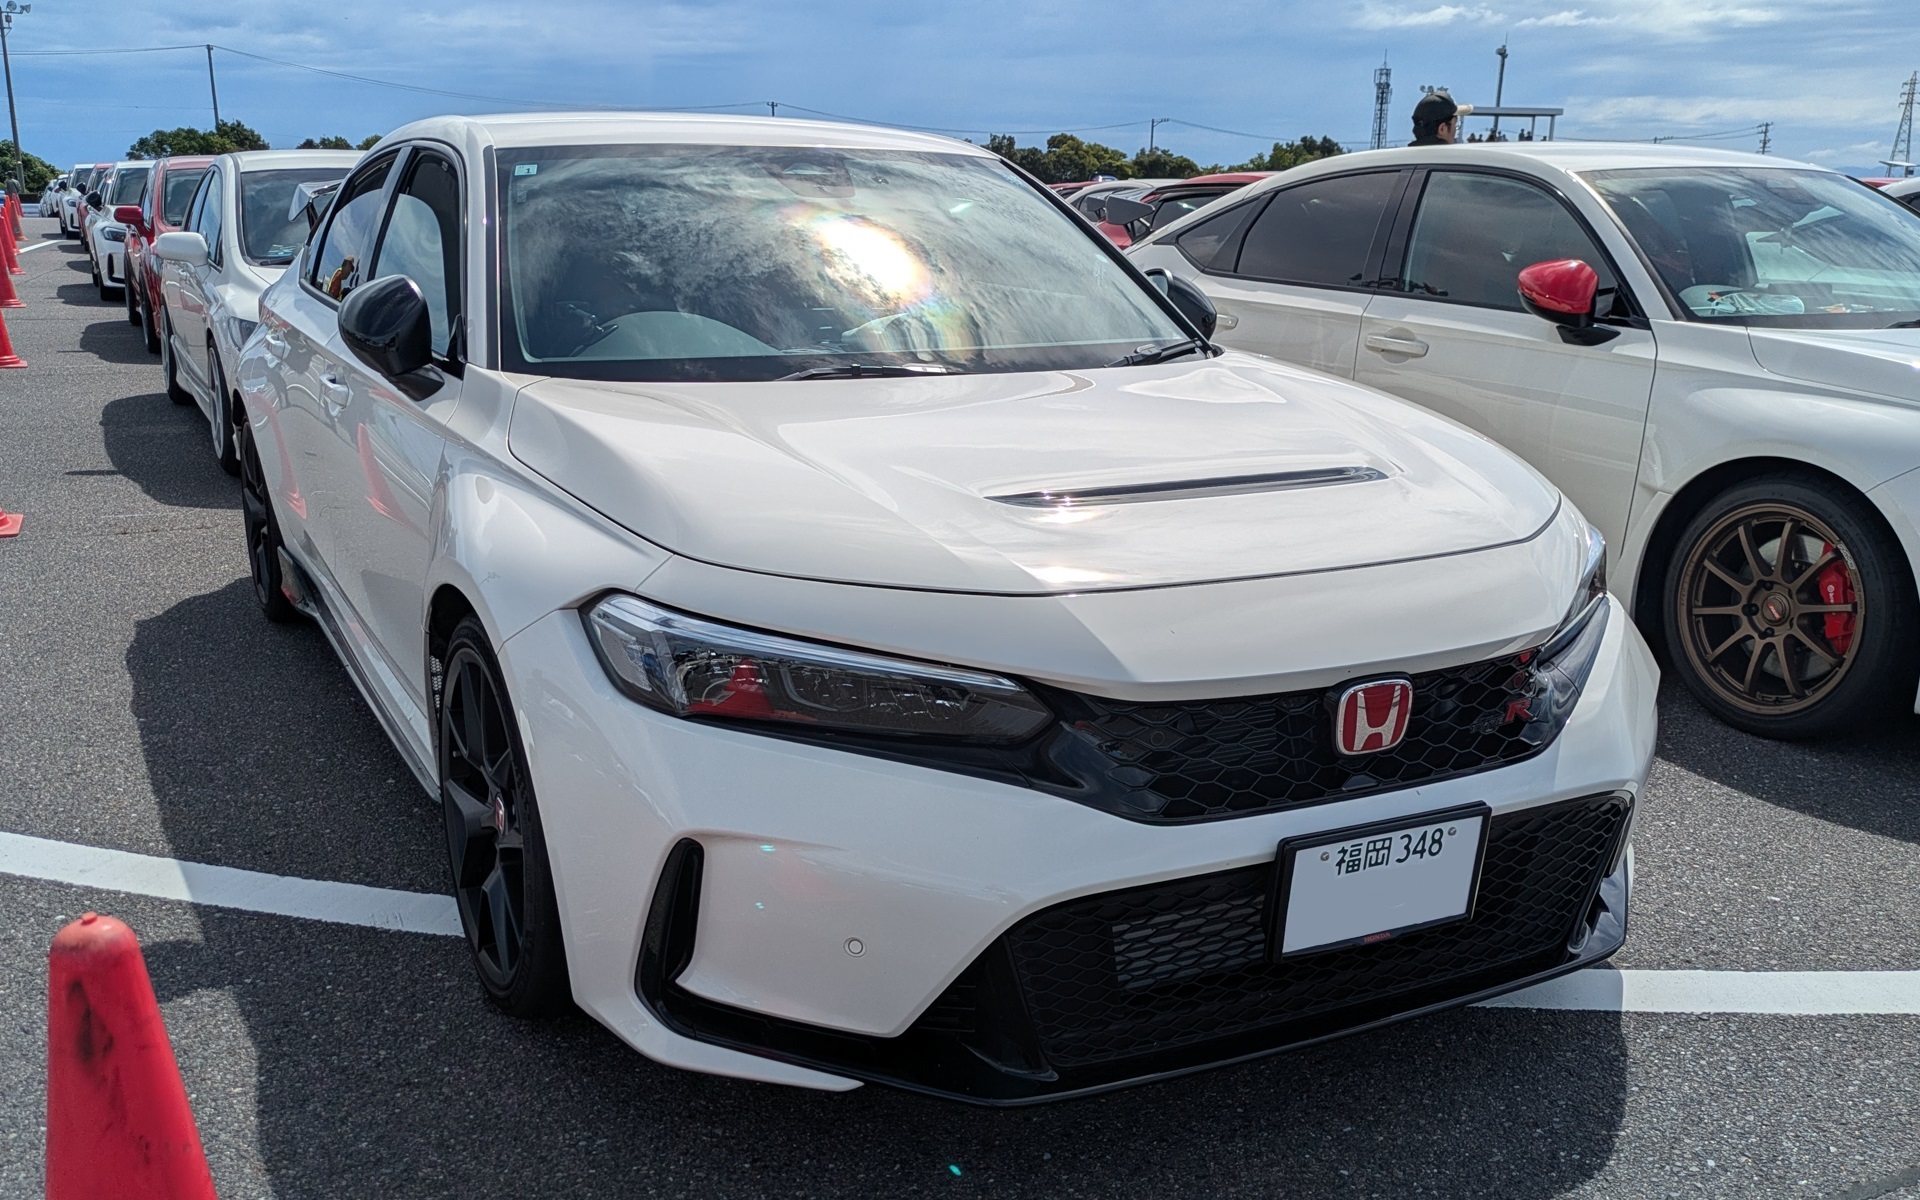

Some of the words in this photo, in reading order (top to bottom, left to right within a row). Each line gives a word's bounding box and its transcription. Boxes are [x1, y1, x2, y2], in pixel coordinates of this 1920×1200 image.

[1503, 698, 1533, 724] R
[1335, 836, 1393, 876] 福岡
[1395, 828, 1444, 864] 348
[1363, 932, 1391, 943] HONDA
